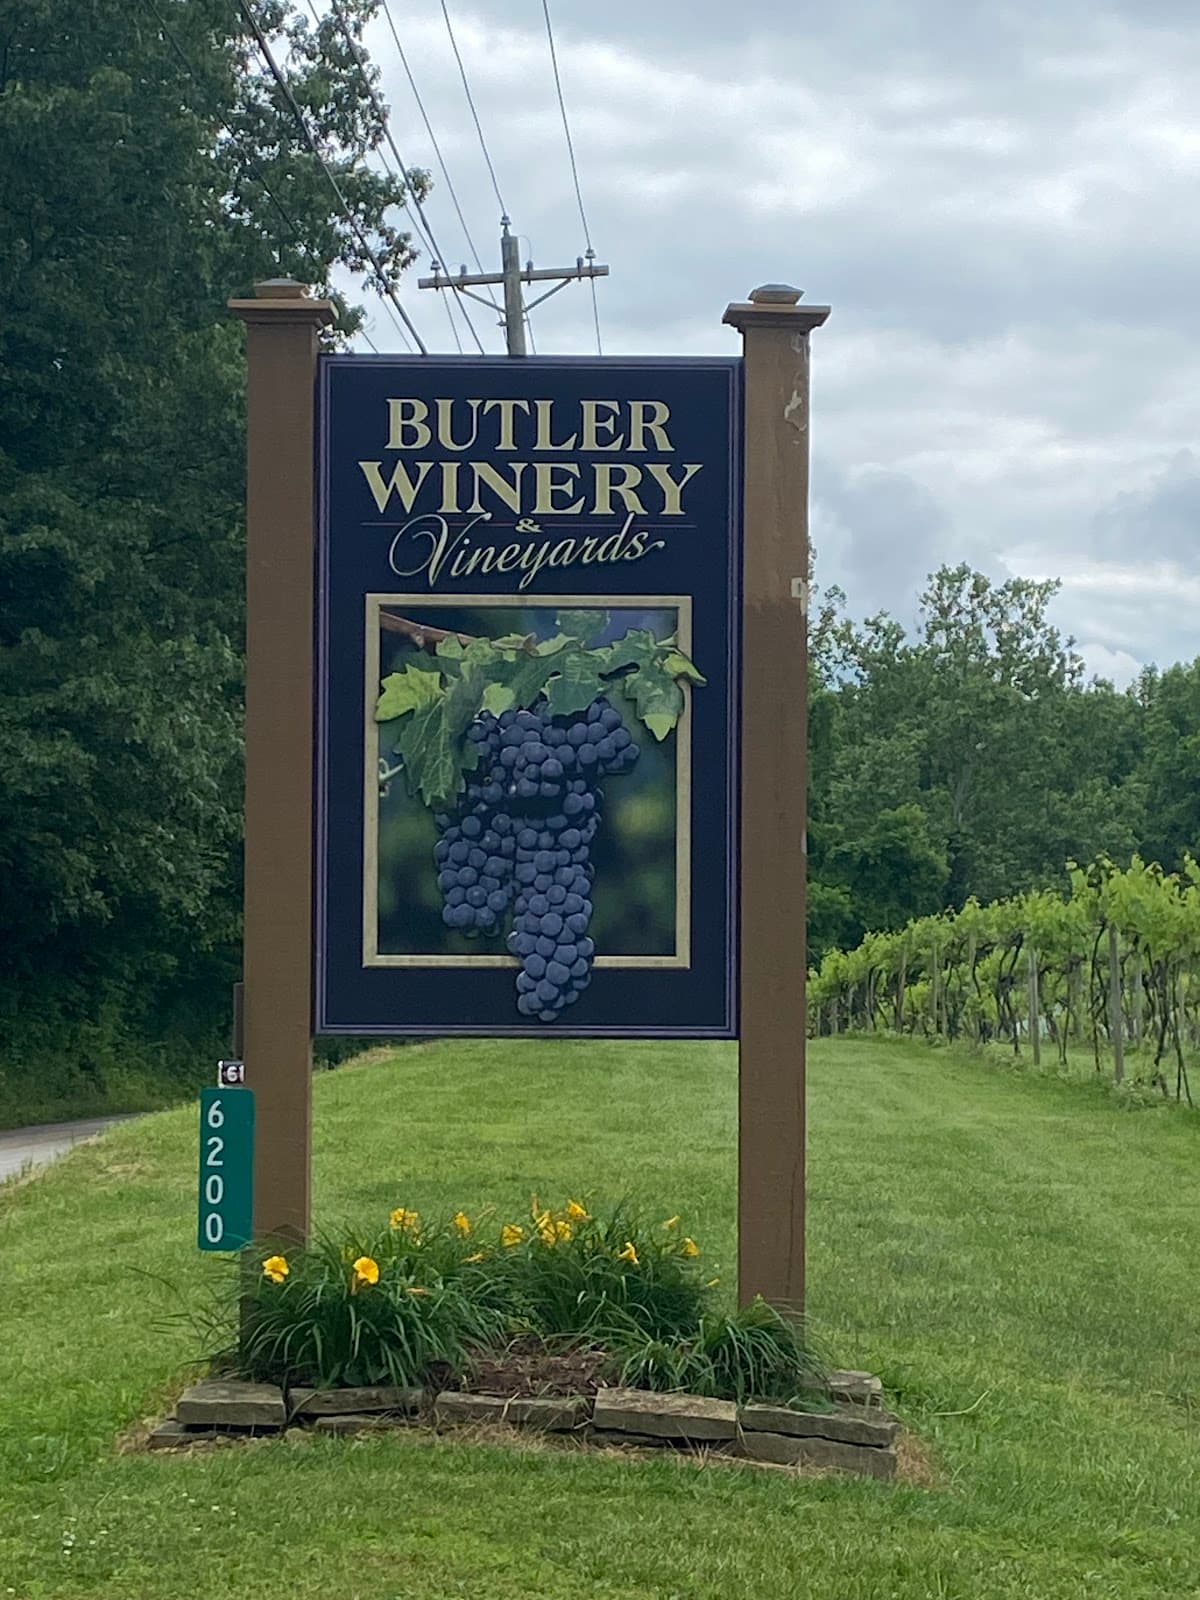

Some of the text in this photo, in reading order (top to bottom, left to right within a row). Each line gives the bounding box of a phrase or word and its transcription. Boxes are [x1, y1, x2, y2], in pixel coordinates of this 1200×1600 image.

[385, 398, 675, 452] BUTLER
[358, 460, 703, 515] WINERY
[388, 511, 665, 589] Vineyards
[515, 518, 543, 533] &
[205, 1100, 225, 1243] 6200
